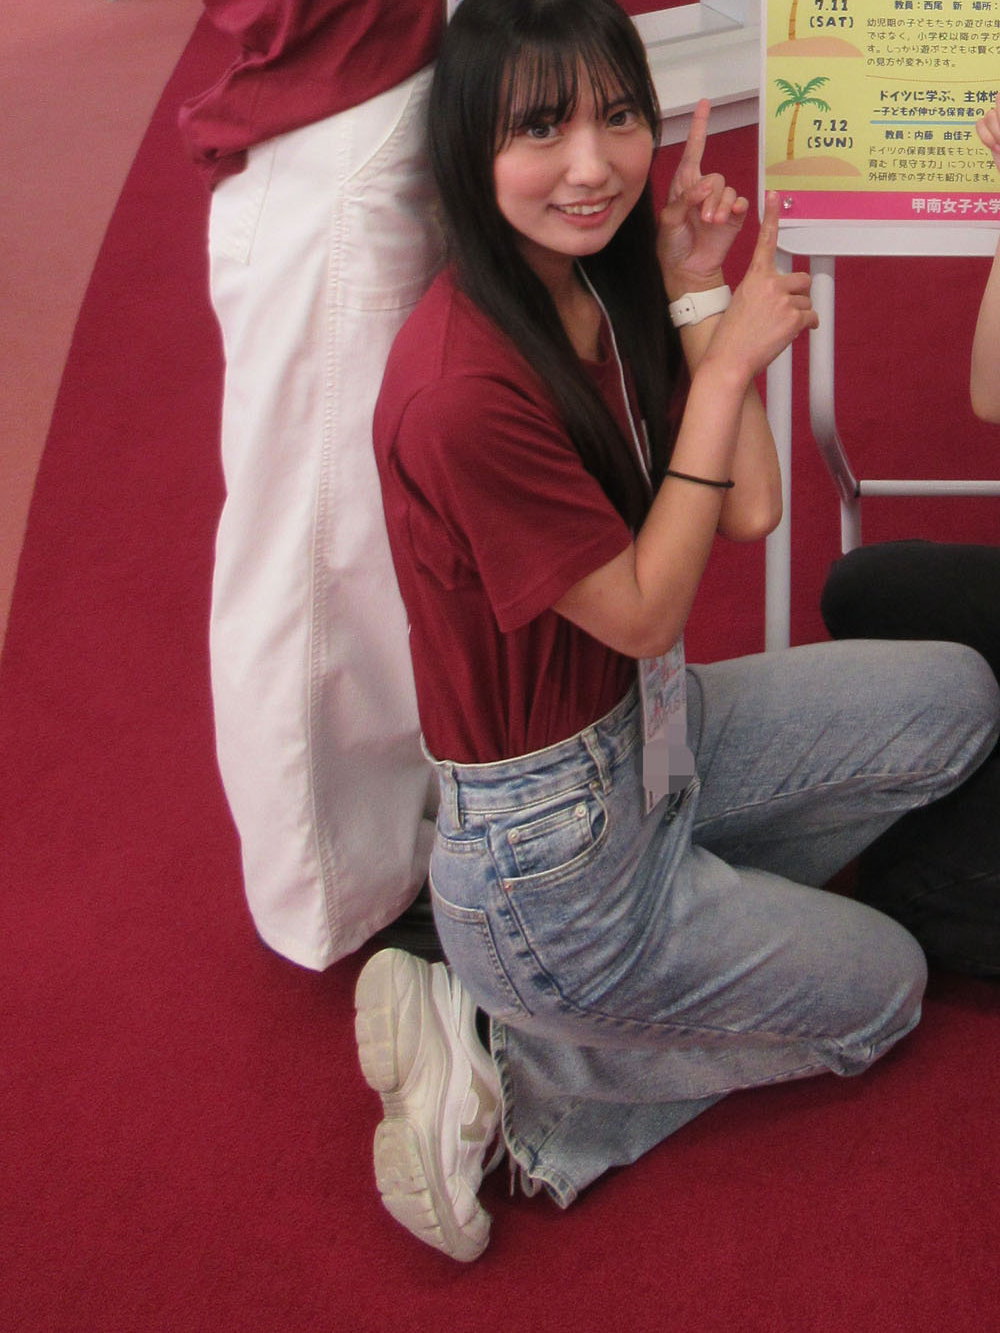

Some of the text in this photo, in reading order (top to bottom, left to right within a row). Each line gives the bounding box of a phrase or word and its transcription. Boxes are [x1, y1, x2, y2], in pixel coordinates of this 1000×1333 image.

[814, 0, 849, 11] 7.11
[894, 0, 943, 11] 教員：西尾
[952, 1, 963, 11] 新
[809, 15, 854, 29] (SAT)
[867, 58, 956, 68] の見方が変わります。
[813, 119, 848, 132] 7.12
[884, 130, 973, 141] 教員：内藤 由佳子
[807, 136, 854, 150] (SUN)
[869, 146, 989, 156] ドイツの保育実践をもとに、
[868, 172, 995, 183] 外研修での学びも紹介します。
